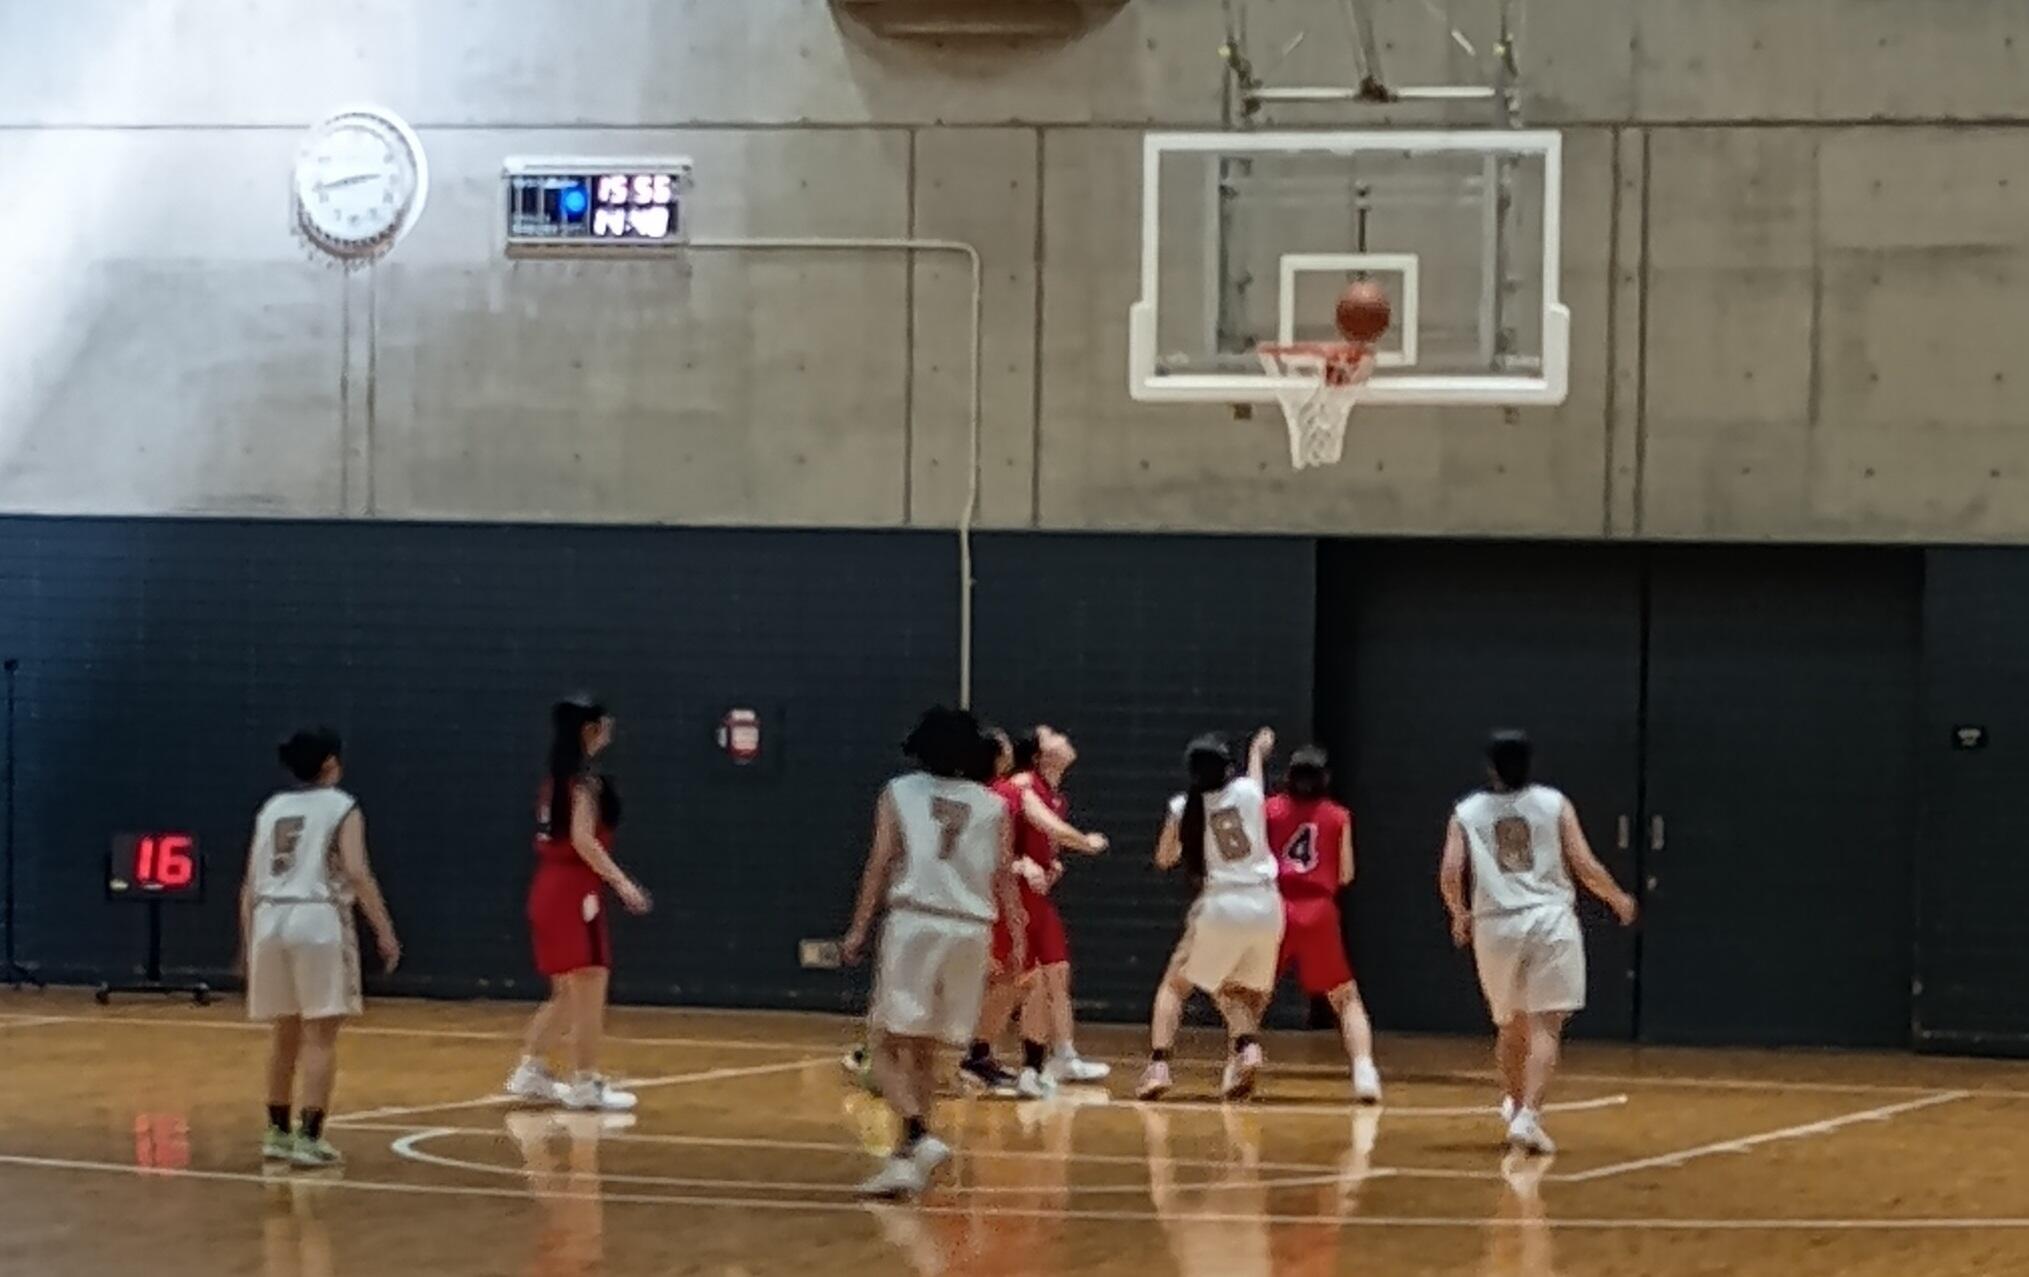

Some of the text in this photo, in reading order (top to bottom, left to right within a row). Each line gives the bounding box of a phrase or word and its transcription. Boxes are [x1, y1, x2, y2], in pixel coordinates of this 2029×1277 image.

[271, 815, 305, 877] 5
[931, 797, 972, 860] 7
[1282, 822, 1319, 873] 4
[136, 836, 193, 885] 16
